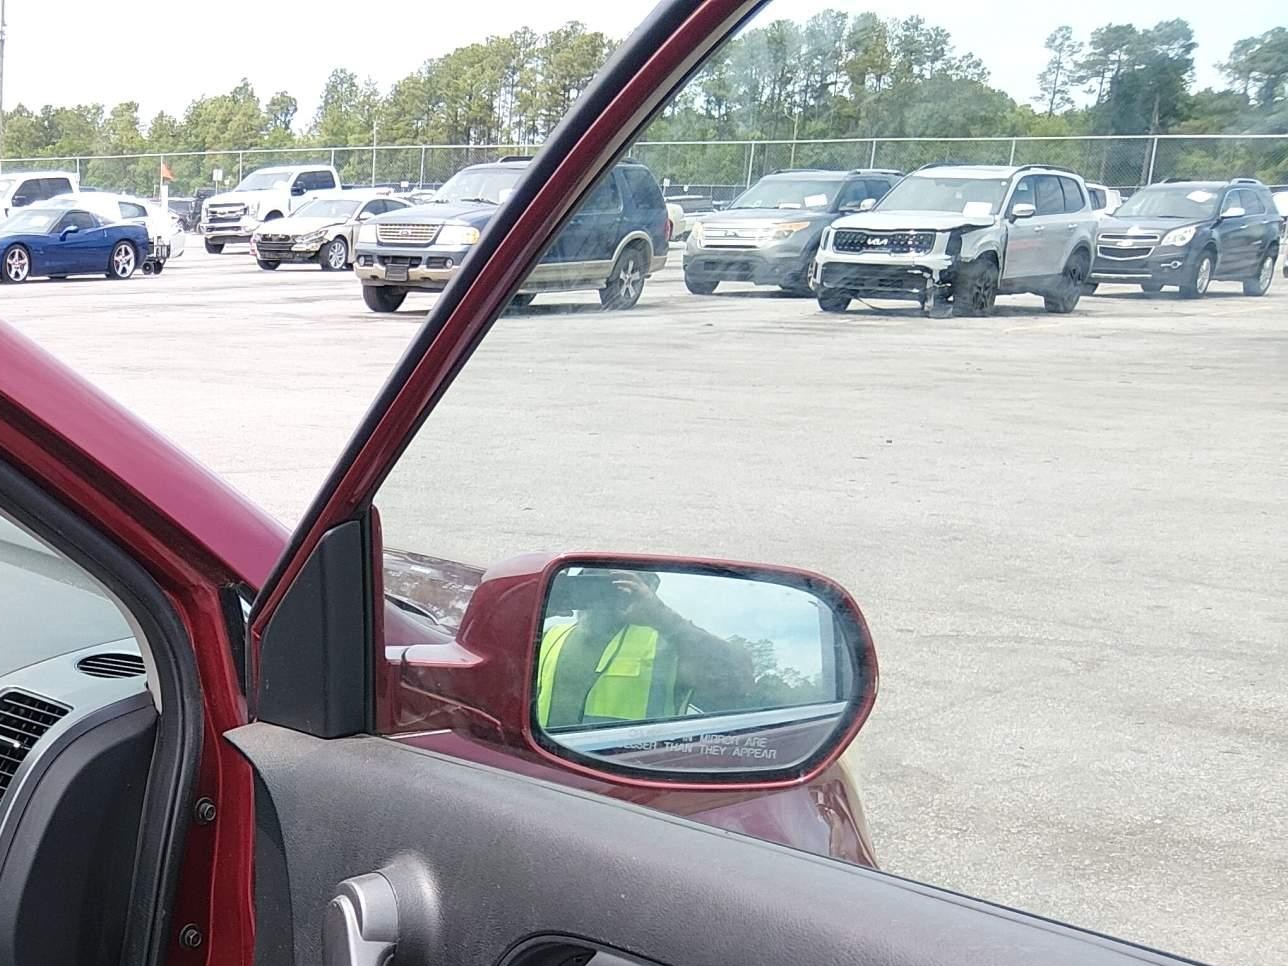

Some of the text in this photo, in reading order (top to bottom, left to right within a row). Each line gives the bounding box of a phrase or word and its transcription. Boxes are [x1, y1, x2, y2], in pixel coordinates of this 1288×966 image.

[699, 734, 739, 746] MIRROR
[745, 737, 768, 748] ARE
[663, 741, 692, 753] THAN
[700, 745, 725, 756] THEY
[732, 748, 777, 759] APPEAR
